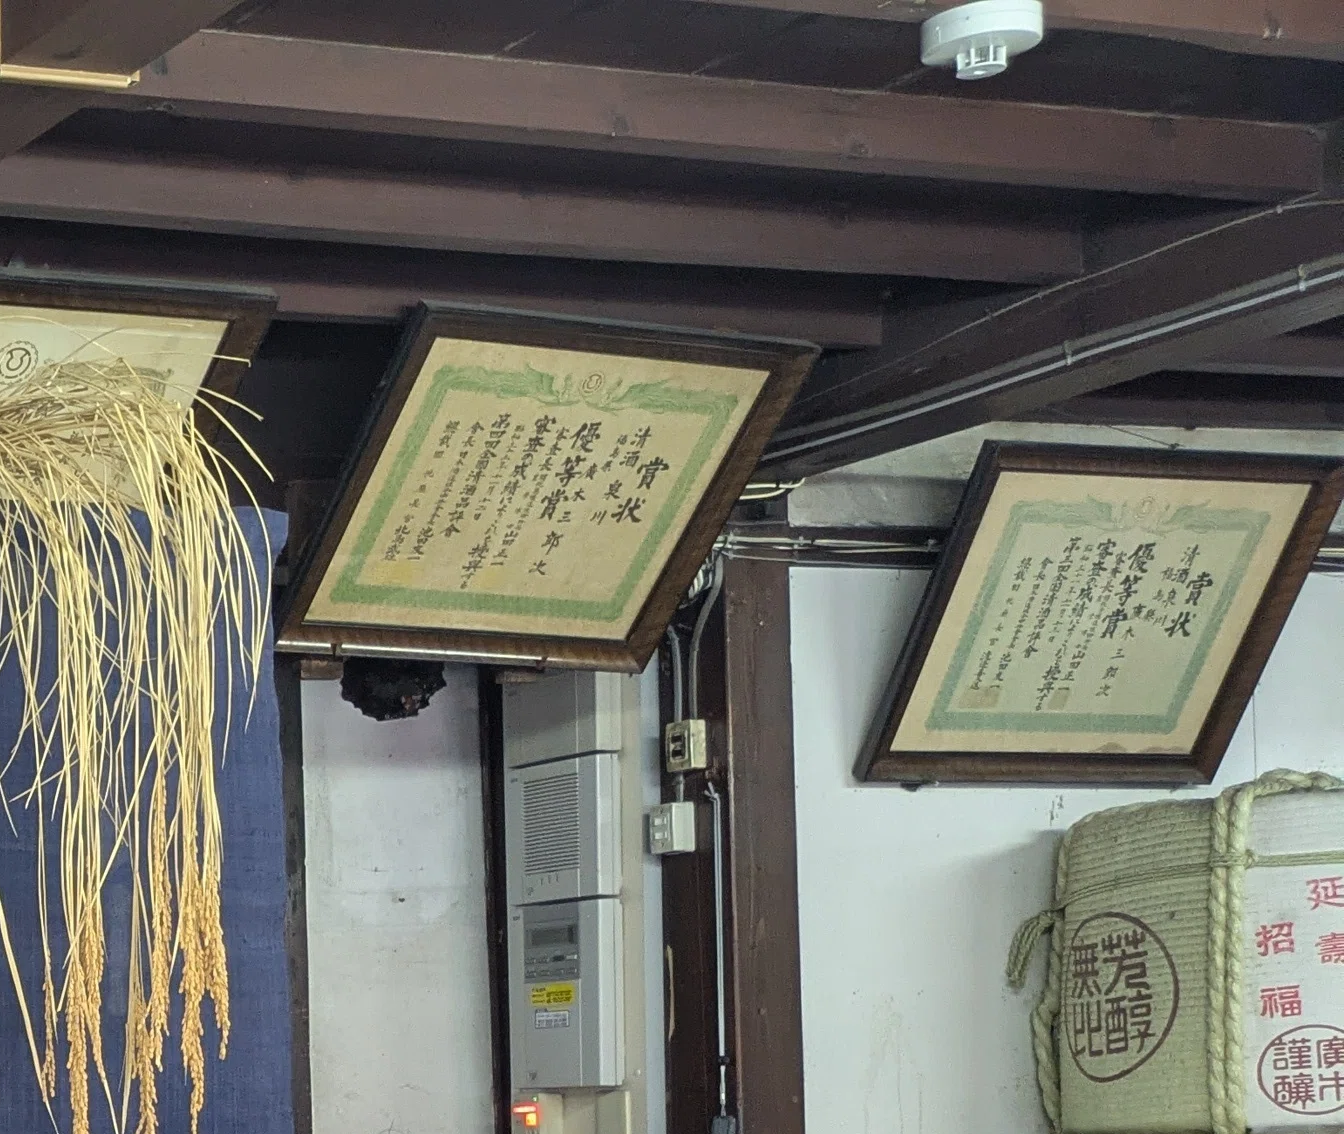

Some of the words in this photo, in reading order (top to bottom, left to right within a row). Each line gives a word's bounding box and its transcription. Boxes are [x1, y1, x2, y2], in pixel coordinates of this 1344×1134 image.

[539, 422, 601, 520] 優等賞
[612, 457, 669, 523] 賞状
[1100, 542, 1157, 639] 優等賞
[1164, 571, 1213, 638] 賞状
[1255, 922, 1302, 1018] 招福
